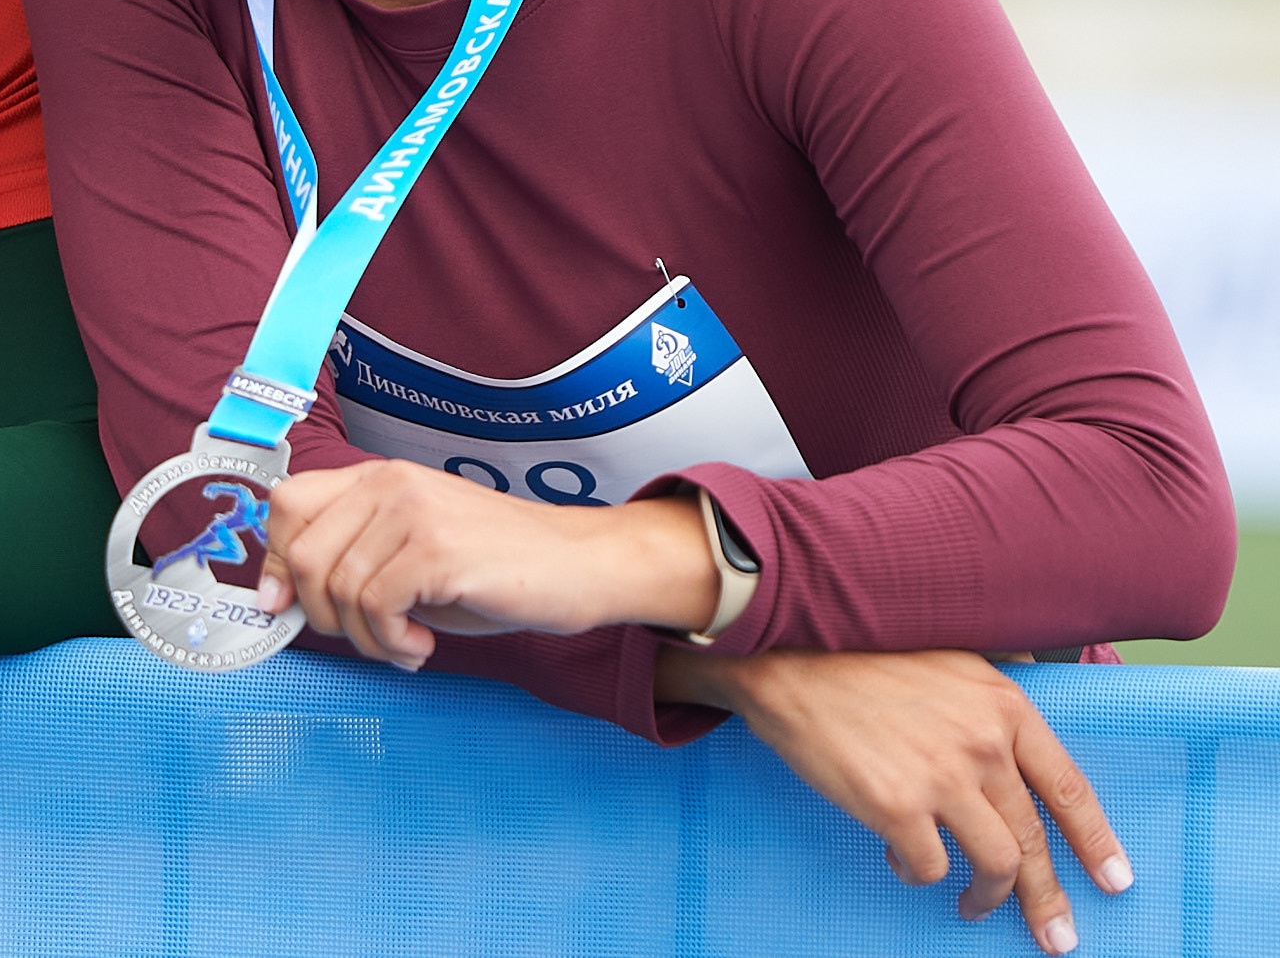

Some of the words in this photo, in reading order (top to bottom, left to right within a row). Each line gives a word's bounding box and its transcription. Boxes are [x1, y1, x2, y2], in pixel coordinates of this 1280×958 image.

[231, 375, 308, 410] ИЖЕВСК
[356, 358, 543, 426] Динамовская
[546, 378, 639, 425] миля
[128, 460, 193, 516] Динамо
[197, 452, 258, 475] бежит
[113, 589, 236, 667] Динамовская
[239, 622, 292, 663] миля
[145, 584, 276, 629] 1923-2023
